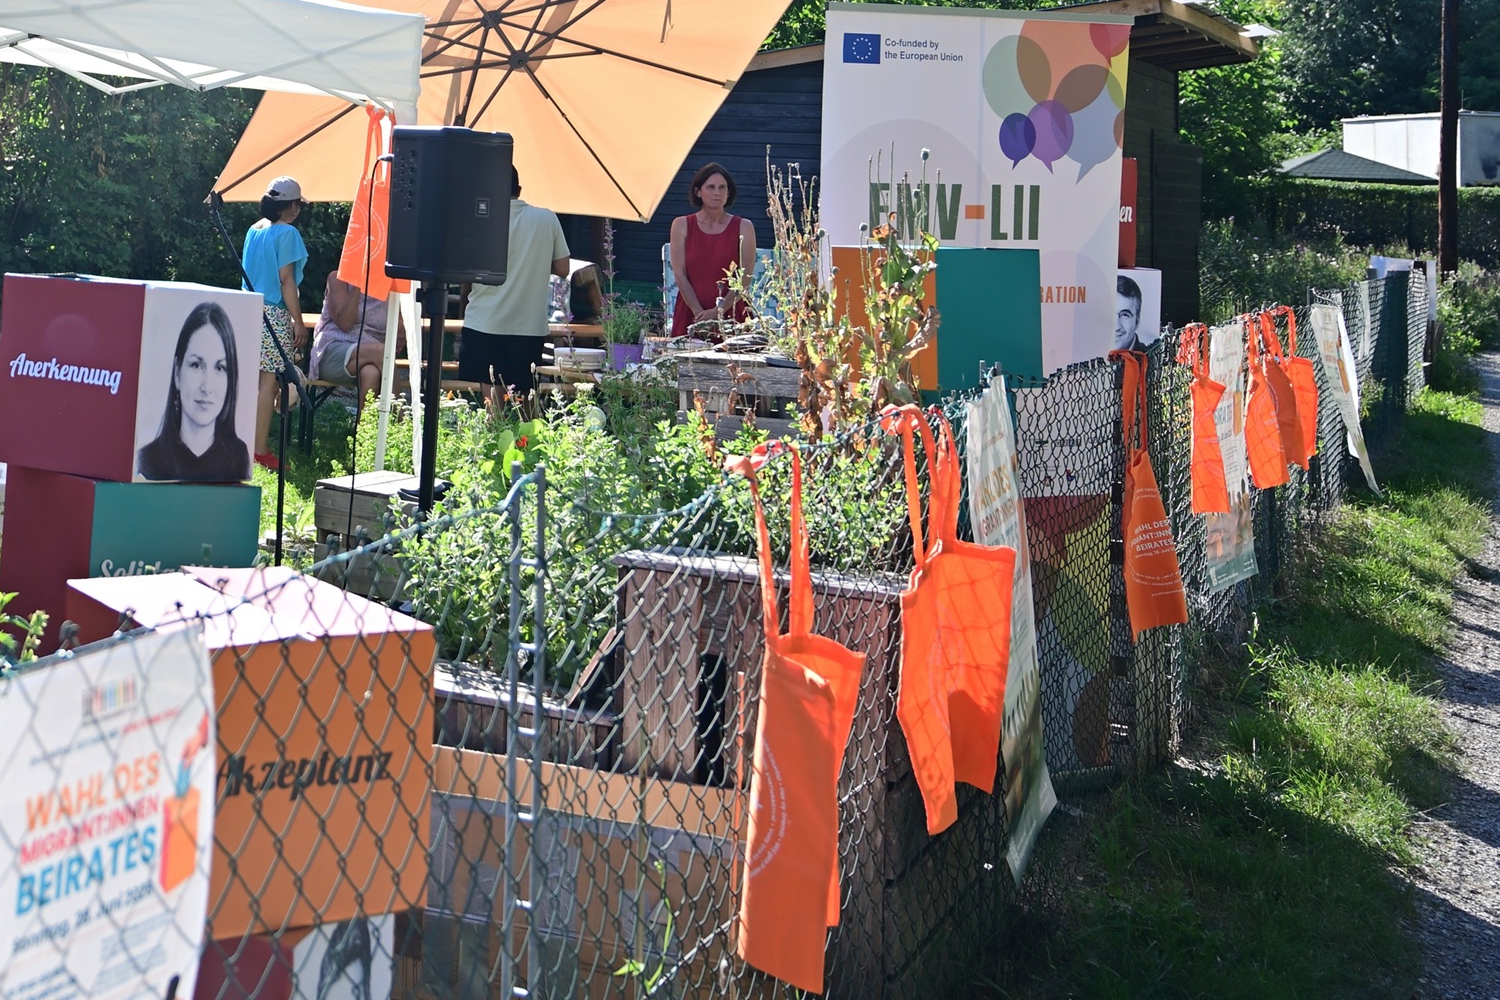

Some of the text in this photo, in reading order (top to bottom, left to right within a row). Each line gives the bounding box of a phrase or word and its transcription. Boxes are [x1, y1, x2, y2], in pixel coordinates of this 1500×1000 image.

[884, 38, 939, 50] Co-funded by
[884, 51, 964, 62] the European Union
[10, 352, 122, 394] Anerkennung
[26, 752, 162, 833] WAHL DES
[216, 751, 393, 801] Akzeptanz
[16, 826, 156, 918] BEIRATES
